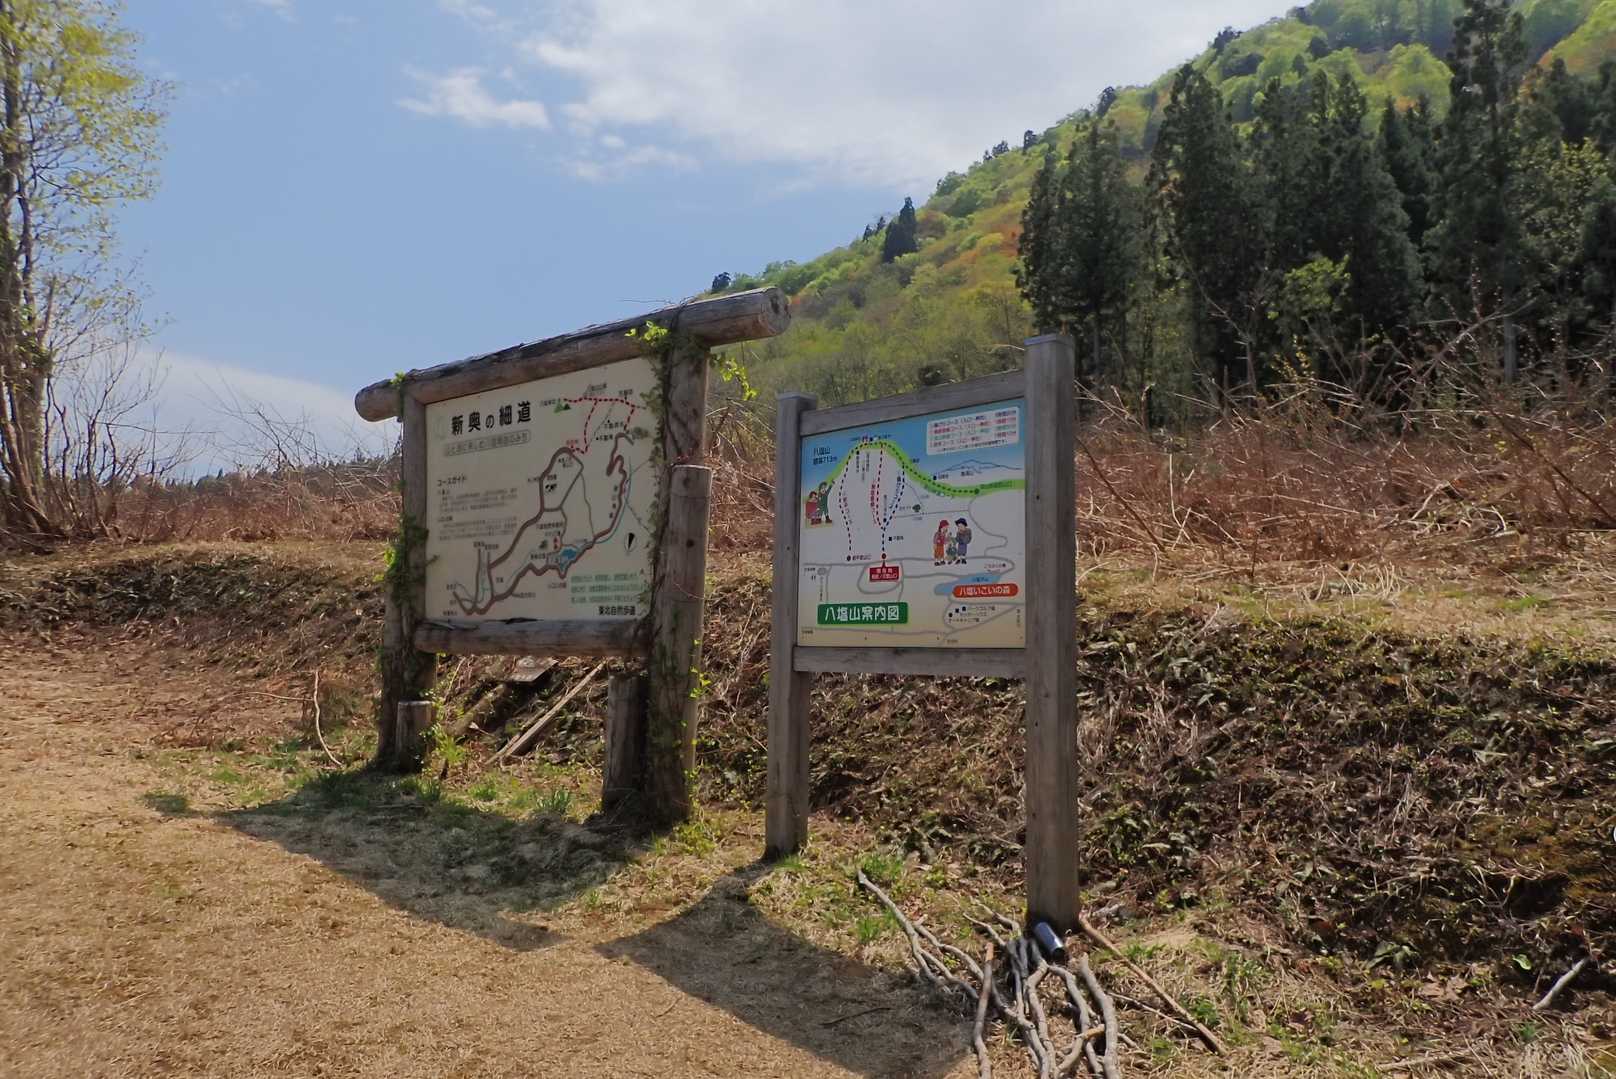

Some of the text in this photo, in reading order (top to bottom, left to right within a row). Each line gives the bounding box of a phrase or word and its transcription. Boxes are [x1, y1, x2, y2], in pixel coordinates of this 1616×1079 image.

[451, 401, 532, 436] 新奥の細道
[825, 605, 899, 622] 八塩山案内図
